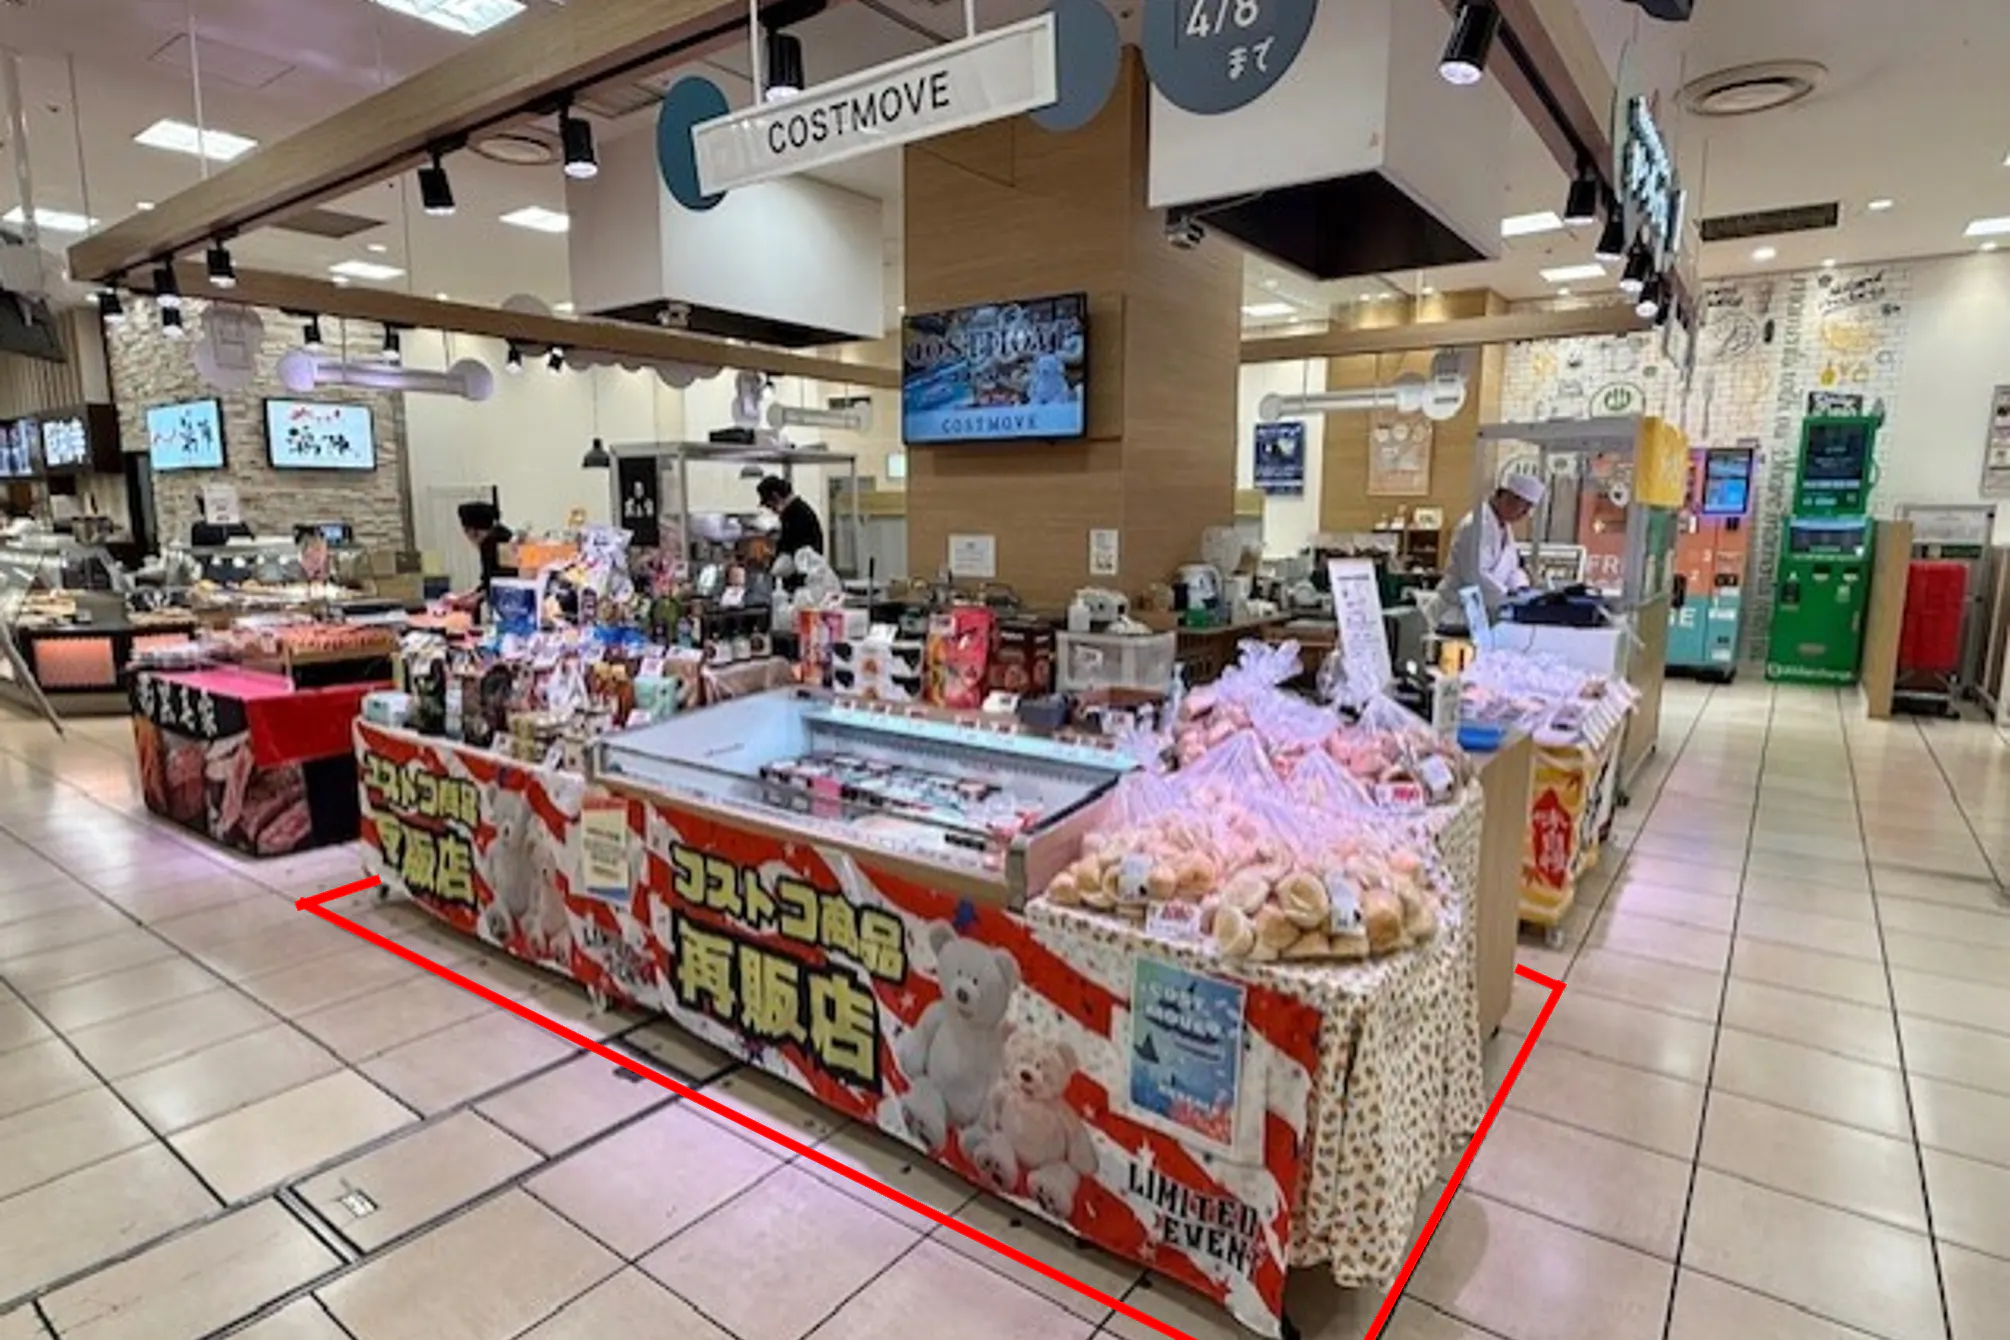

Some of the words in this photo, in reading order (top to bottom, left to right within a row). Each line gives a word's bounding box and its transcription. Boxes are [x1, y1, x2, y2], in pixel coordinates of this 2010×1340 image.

[1228, 36, 1275, 79] まで
[768, 70, 951, 153] COSTMOVE
[941, 416, 1038, 433] COSTMOVE
[671, 843, 905, 984] コストコ商品
[677, 915, 879, 1085] 再販店
[1128, 1163, 1258, 1238] LIMITED
